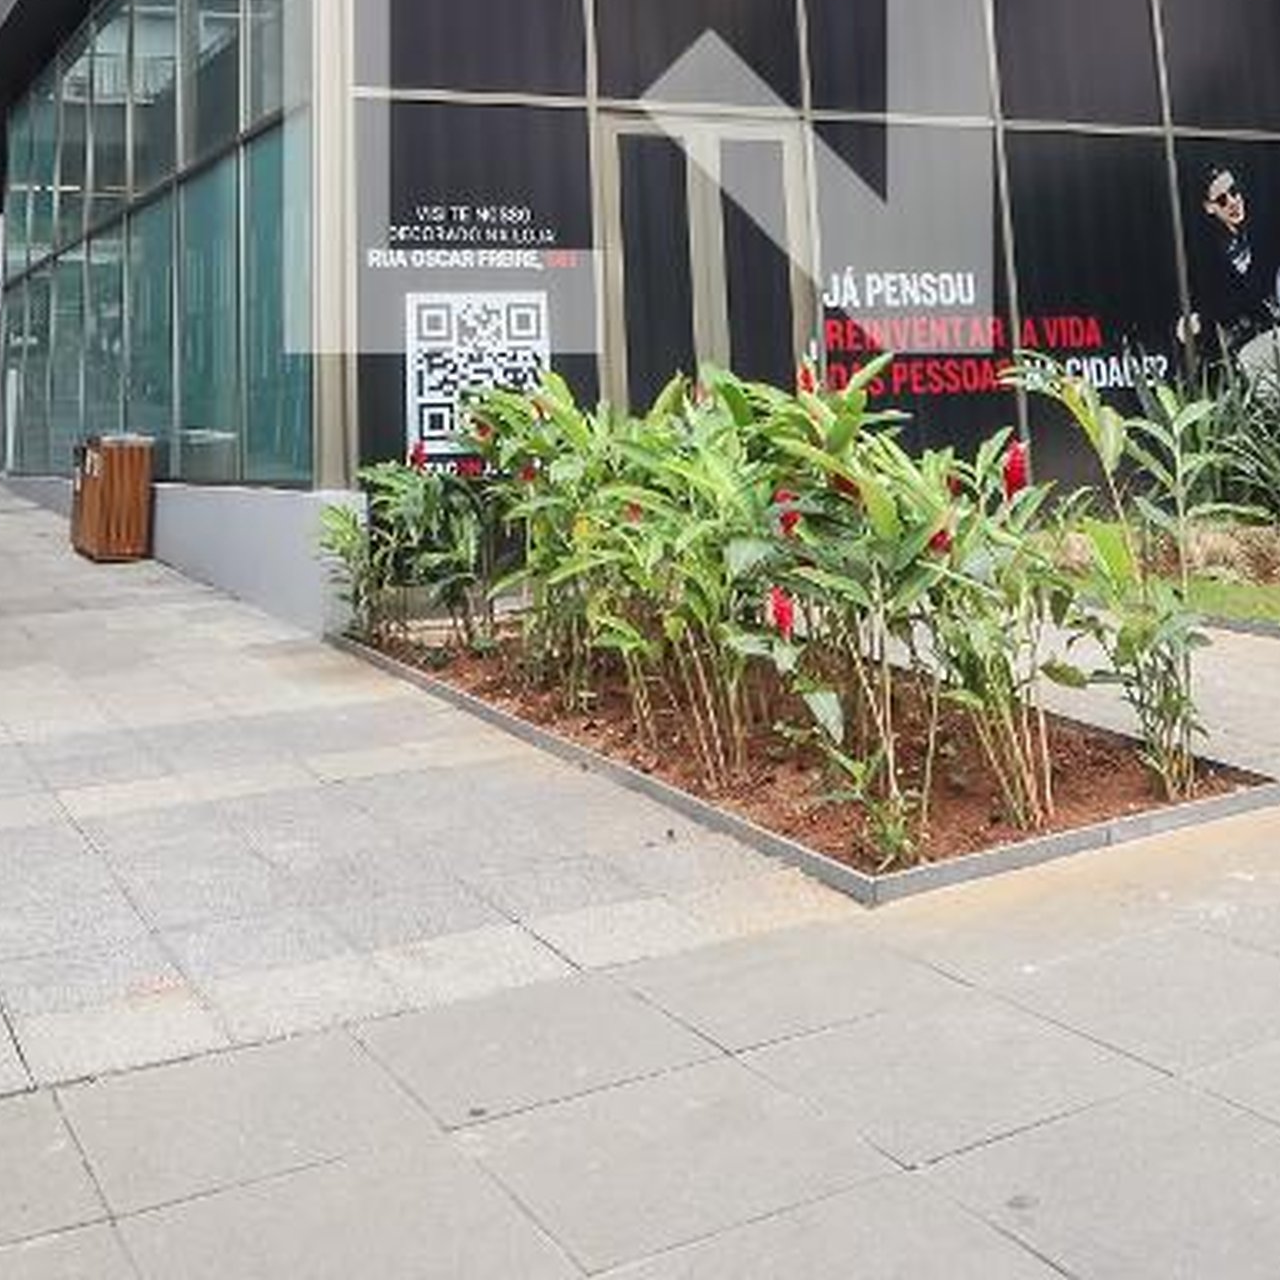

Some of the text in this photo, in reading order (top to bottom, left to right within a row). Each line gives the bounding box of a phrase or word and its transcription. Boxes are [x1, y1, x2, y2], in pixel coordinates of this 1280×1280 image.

[368, 249, 408, 268] RUA
[410, 249, 475, 268] OSCAR
[823, 266, 975, 308] JÁ PENSOU
[825, 316, 1102, 352] REINVENTAR A VIDA
